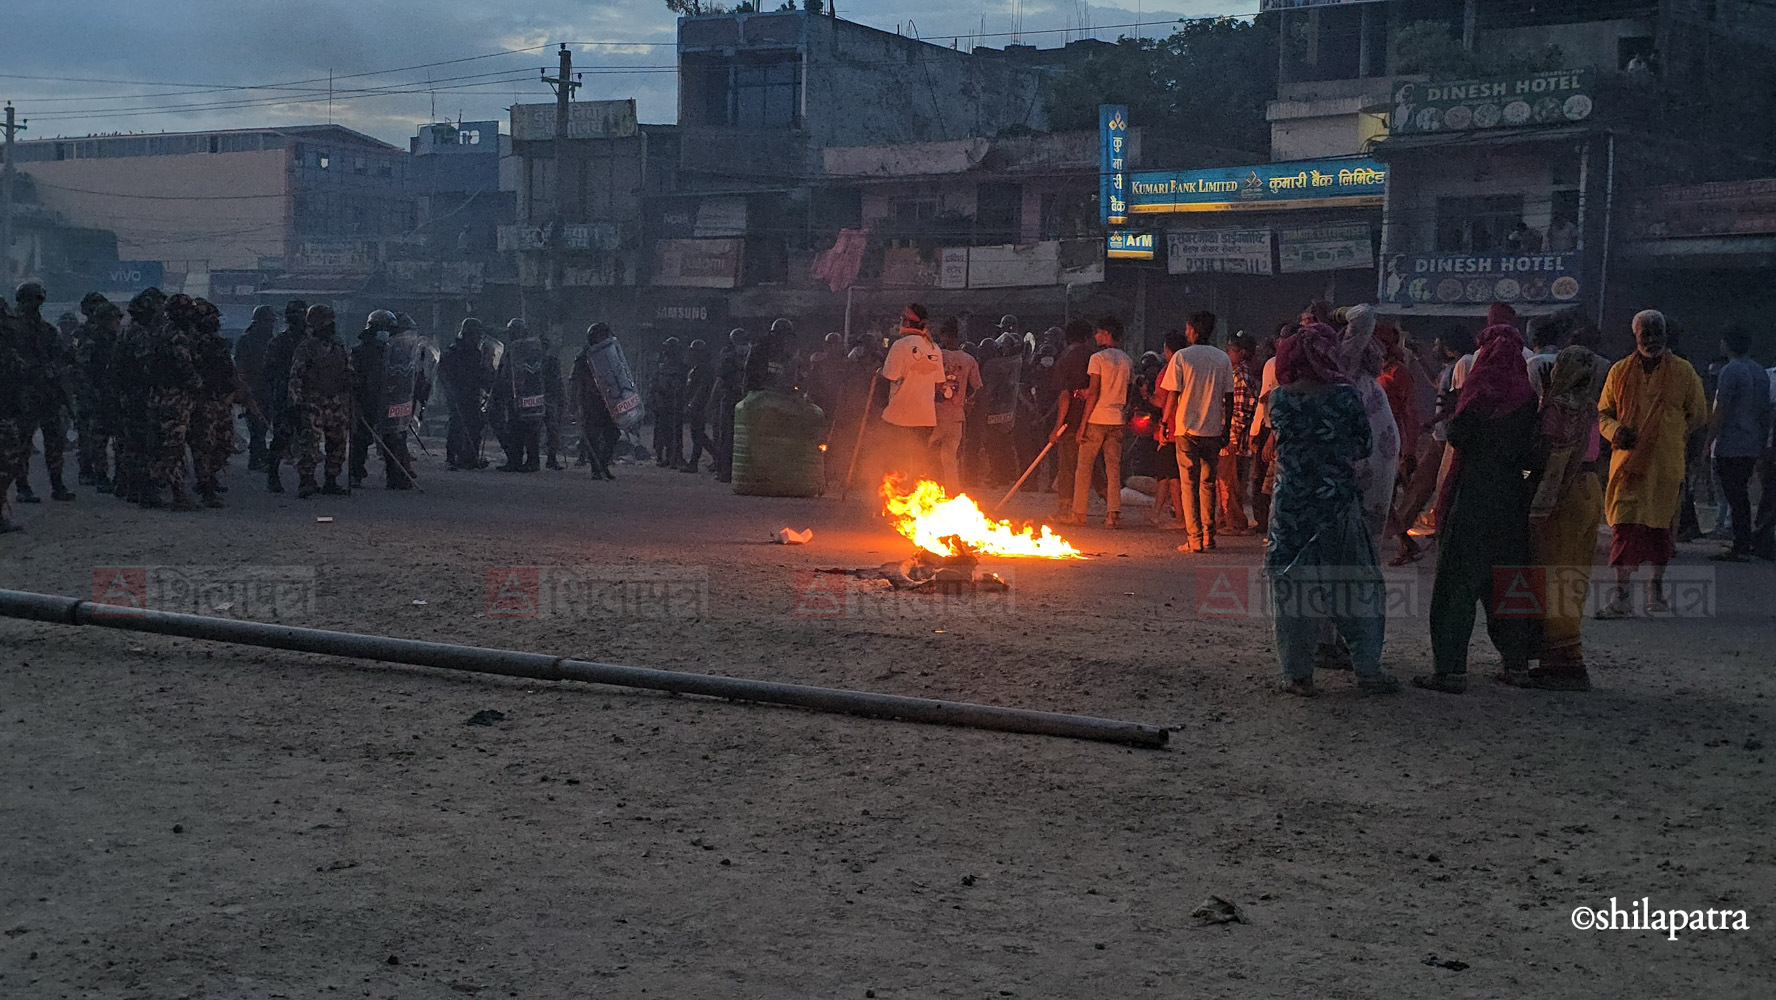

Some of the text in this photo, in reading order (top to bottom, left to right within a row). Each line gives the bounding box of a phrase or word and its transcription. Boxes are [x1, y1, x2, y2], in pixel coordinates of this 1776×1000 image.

[1427, 81, 1507, 101] DINESH
[1516, 75, 1581, 94] HOTEL
[1269, 172, 1307, 194] कुमारी
[1338, 168, 1386, 187] लिमिटेड
[1126, 233, 1153, 248] ATM
[1415, 256, 1565, 274] DINESH HOTEL
[111, 269, 142, 282] vivo
[655, 306, 708, 320] SAMSUNG
